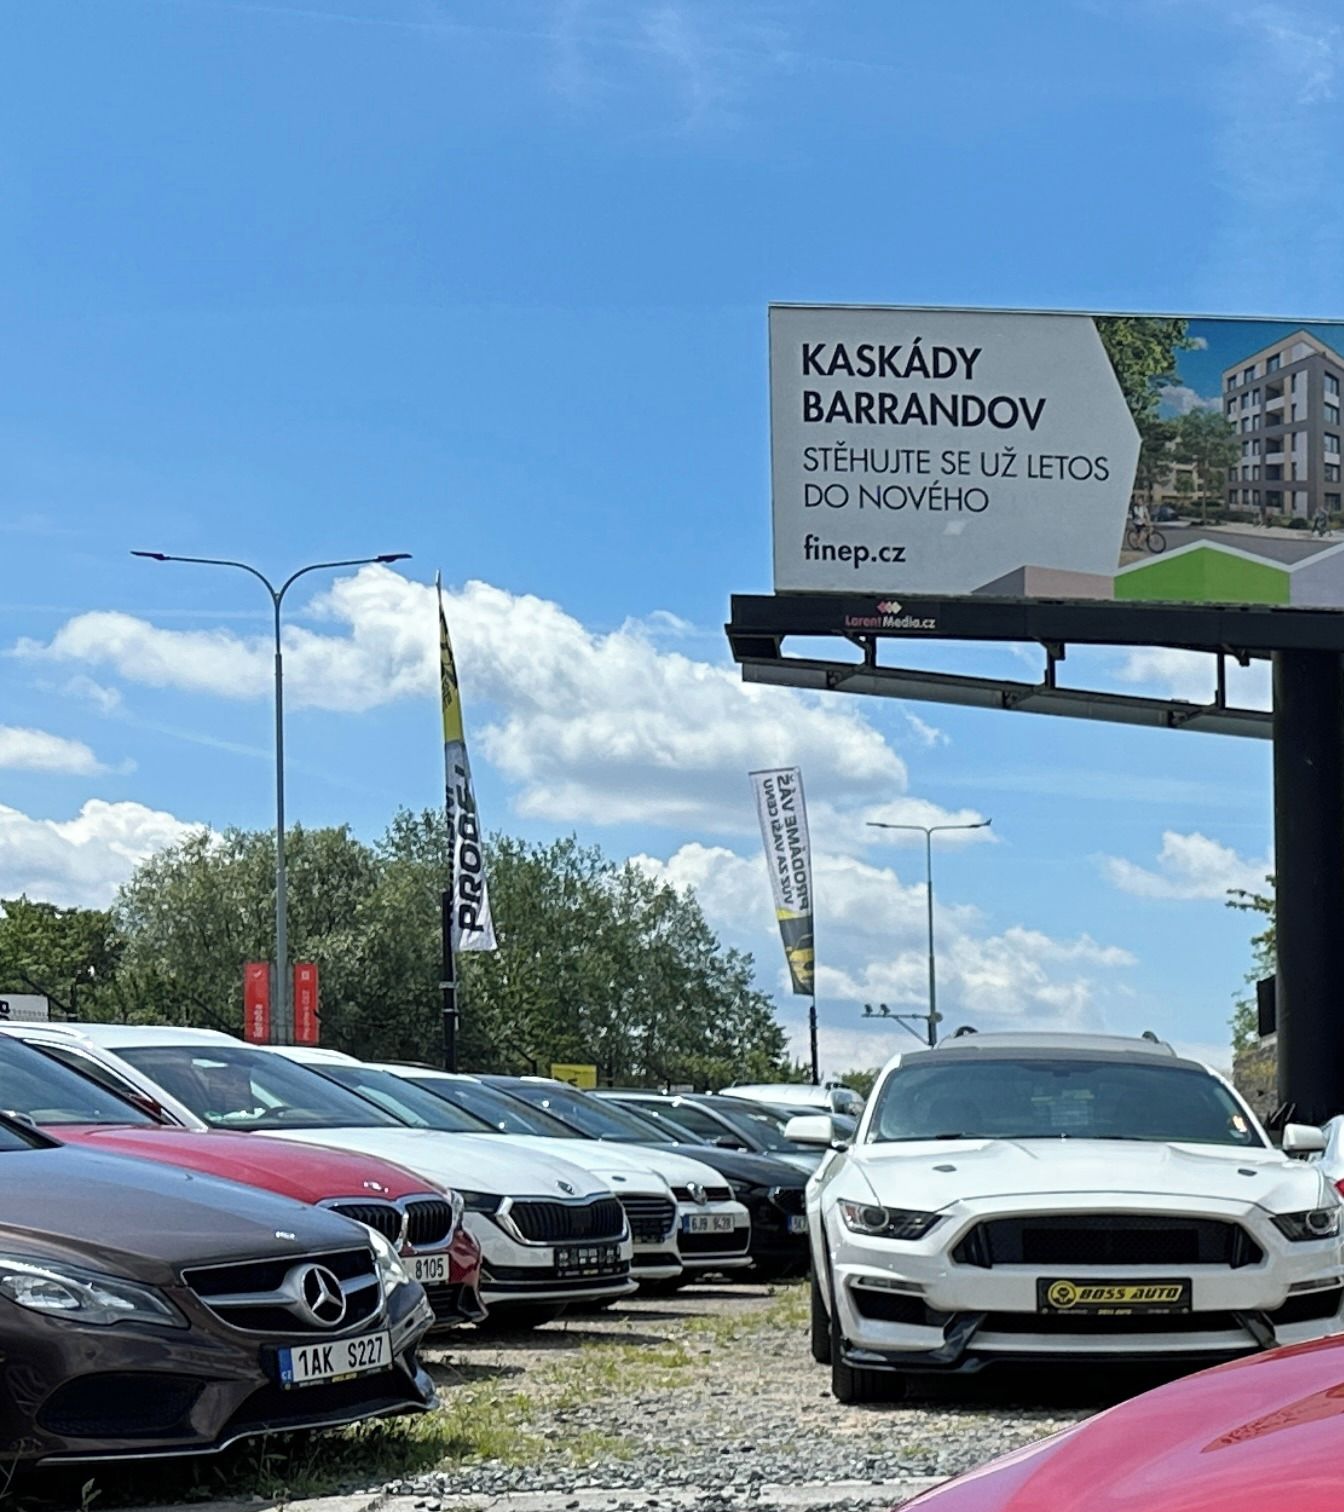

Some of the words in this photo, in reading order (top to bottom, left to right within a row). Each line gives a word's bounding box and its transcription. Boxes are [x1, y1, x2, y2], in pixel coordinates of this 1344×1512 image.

[802, 337, 982, 380] KASKÁDY
[803, 390, 1046, 431] BARRANDOV
[803, 441, 930, 474] STĚHUJTE
[941, 450, 971, 475] SE
[981, 447, 1018, 478] UŽ
[1027, 454, 1109, 481] LETOS
[804, 483, 849, 508] DO
[859, 480, 989, 513] NOVÉHO
[803, 534, 906, 569] finep.cz
[415, 1257, 444, 1279] 8105
[1079, 1288, 1126, 1300] BOSS
[1131, 1287, 1179, 1299] AUTO
[298, 1346, 334, 1376] 1AK
[347, 1336, 383, 1368] S227
